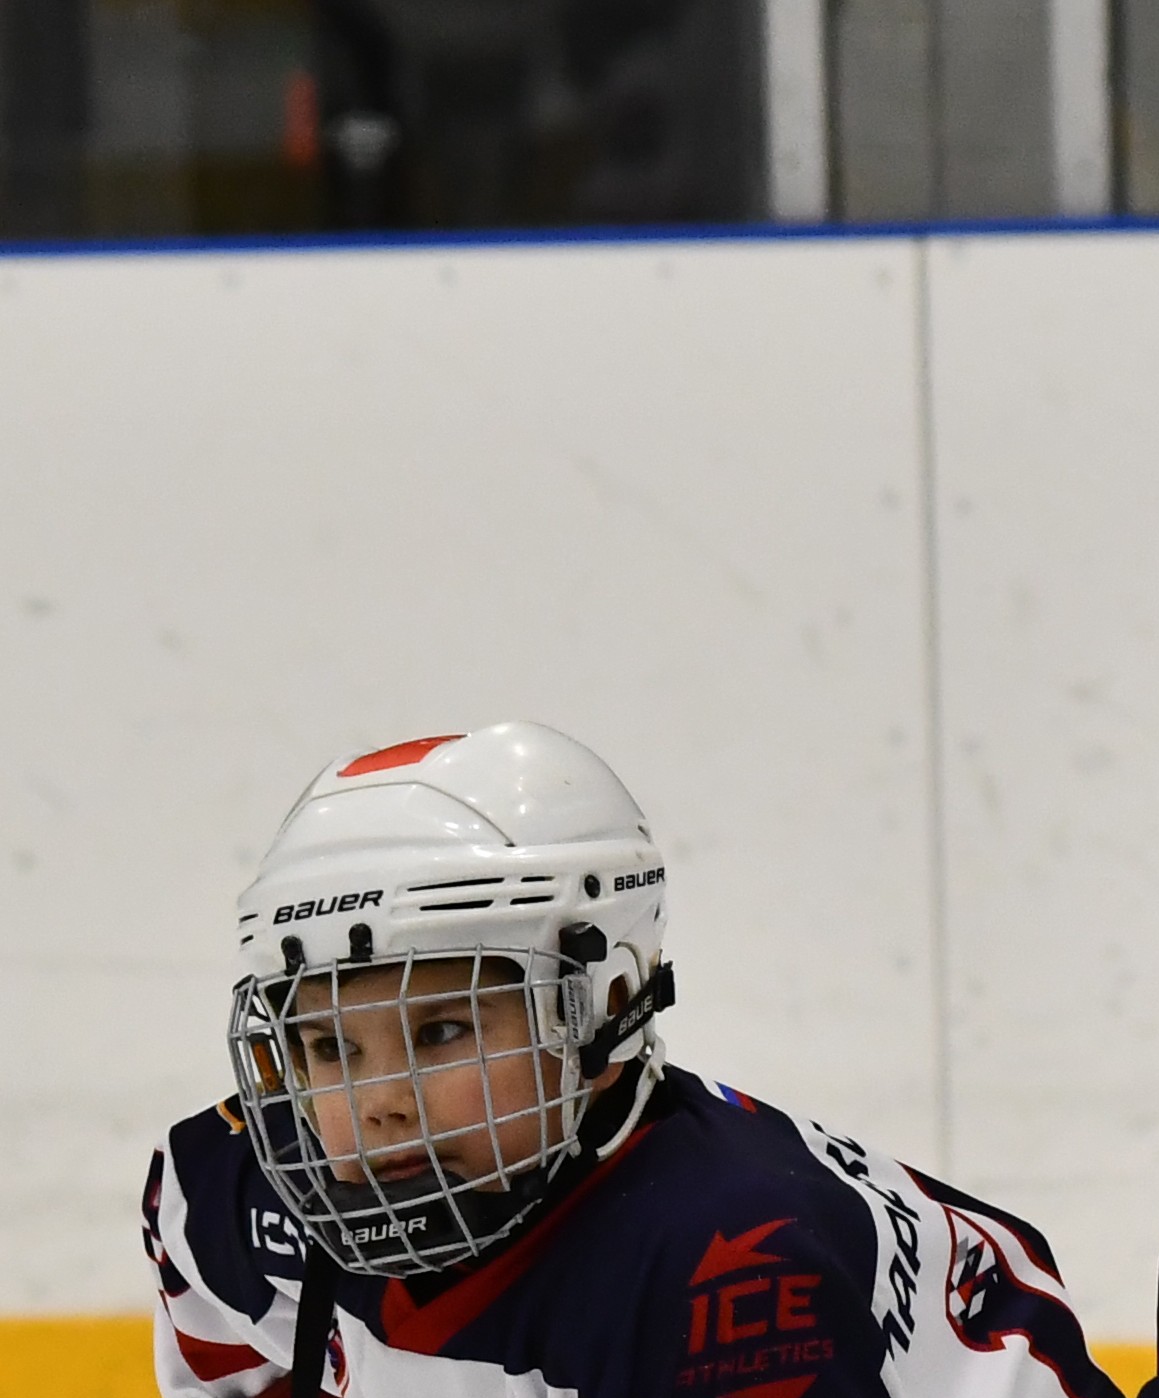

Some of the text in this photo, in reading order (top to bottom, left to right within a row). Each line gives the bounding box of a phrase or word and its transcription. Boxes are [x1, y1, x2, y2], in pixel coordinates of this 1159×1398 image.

[614, 867, 665, 892] BAUER
[273, 889, 384, 925] BAUER
[617, 994, 653, 1036] BAUE
[689, 1274, 822, 1356] ICE
